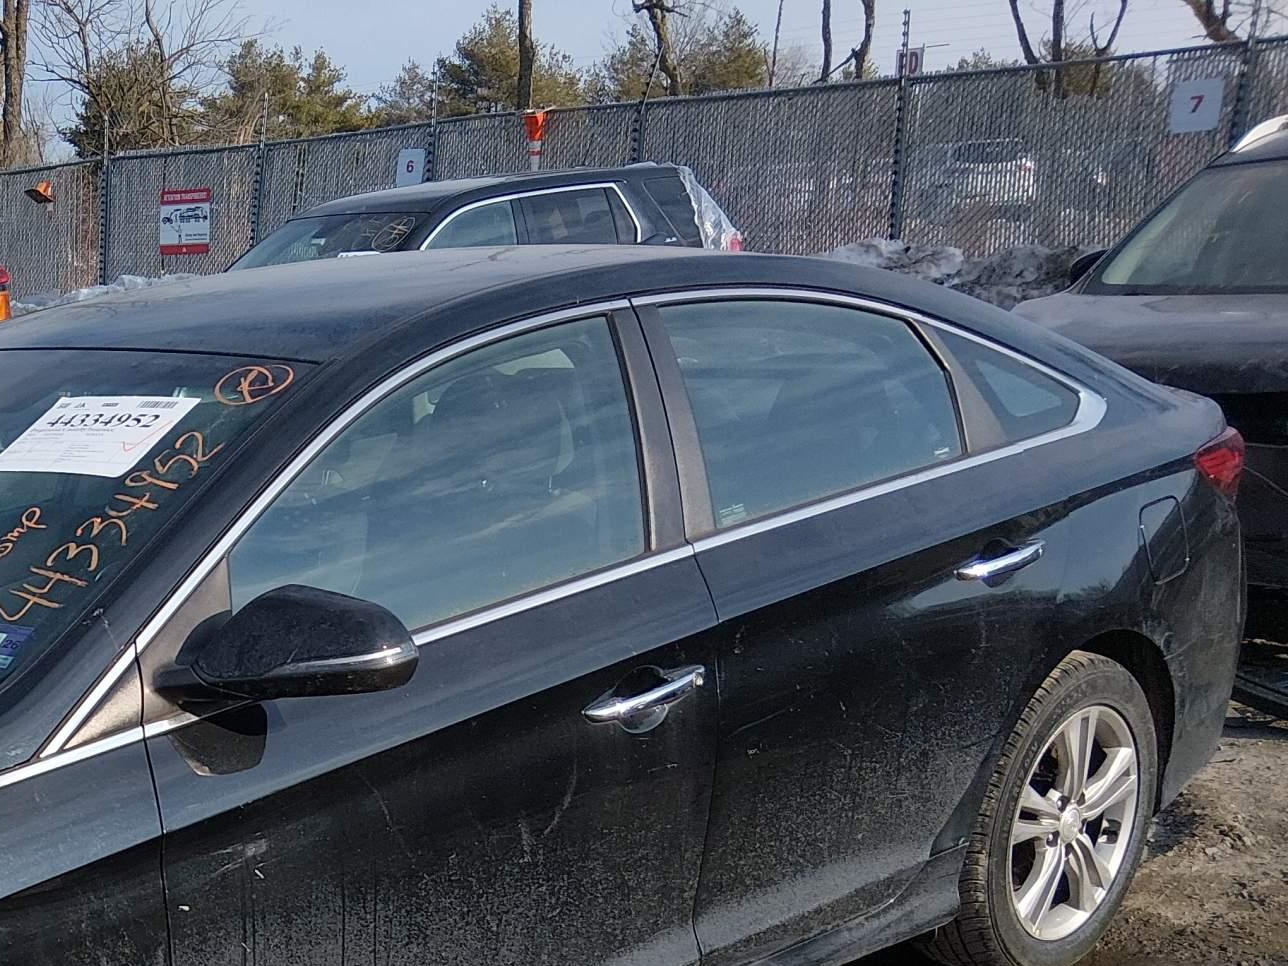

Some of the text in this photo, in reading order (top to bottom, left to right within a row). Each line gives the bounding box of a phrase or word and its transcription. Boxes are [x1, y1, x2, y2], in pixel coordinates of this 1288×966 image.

[1190, 95, 1205, 114] 7
[406, 160, 415, 173] 6
[46, 411, 161, 428] 44334952
[3, 639, 21, 649] 26
